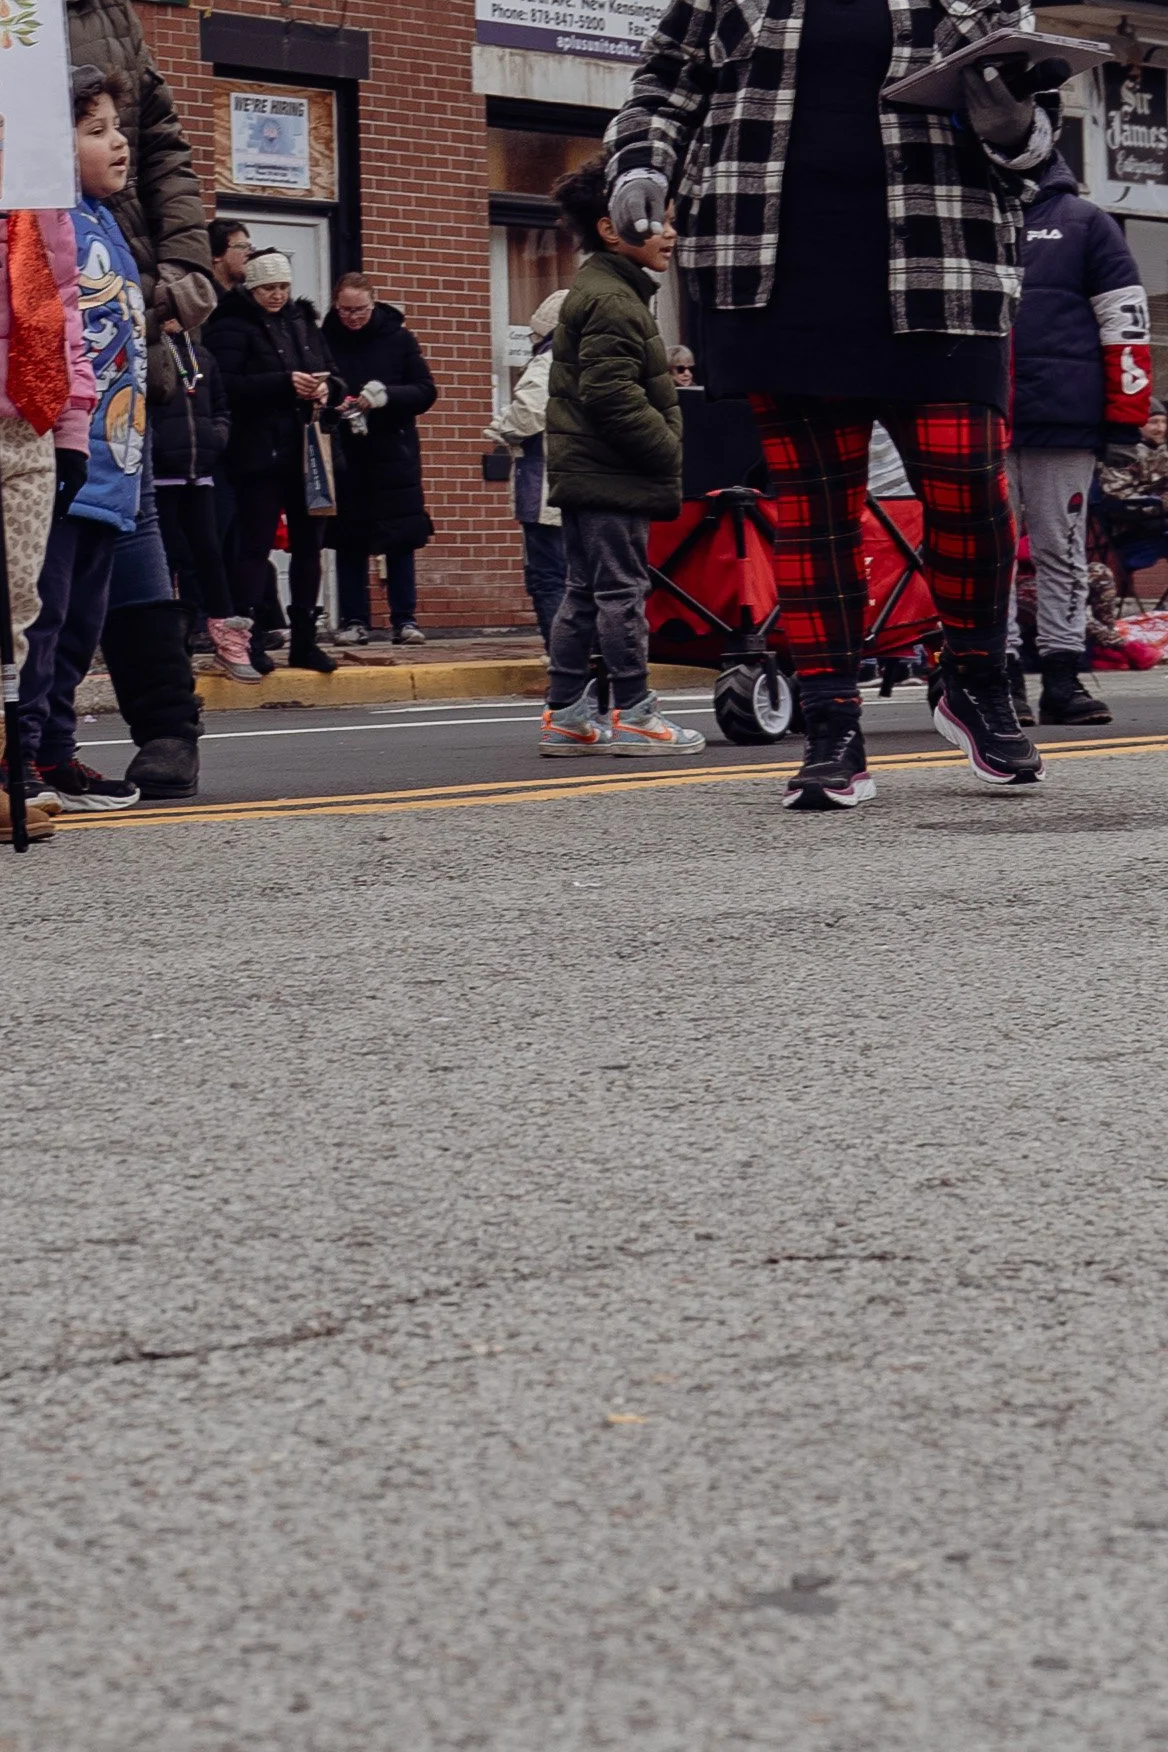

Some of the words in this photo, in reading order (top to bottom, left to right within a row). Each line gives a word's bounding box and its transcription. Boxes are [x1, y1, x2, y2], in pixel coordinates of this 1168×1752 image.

[491, 3, 528, 21] Phone:
[608, 0, 663, 22] Kensingto
[556, 34, 641, 56] aplusunitedhc.
[234, 96, 268, 114] WE'RE
[270, 100, 305, 117] HIRING
[1120, 80, 1153, 118] Sir
[1106, 111, 1167, 152] James
[1026, 229, 1064, 242] FILA
